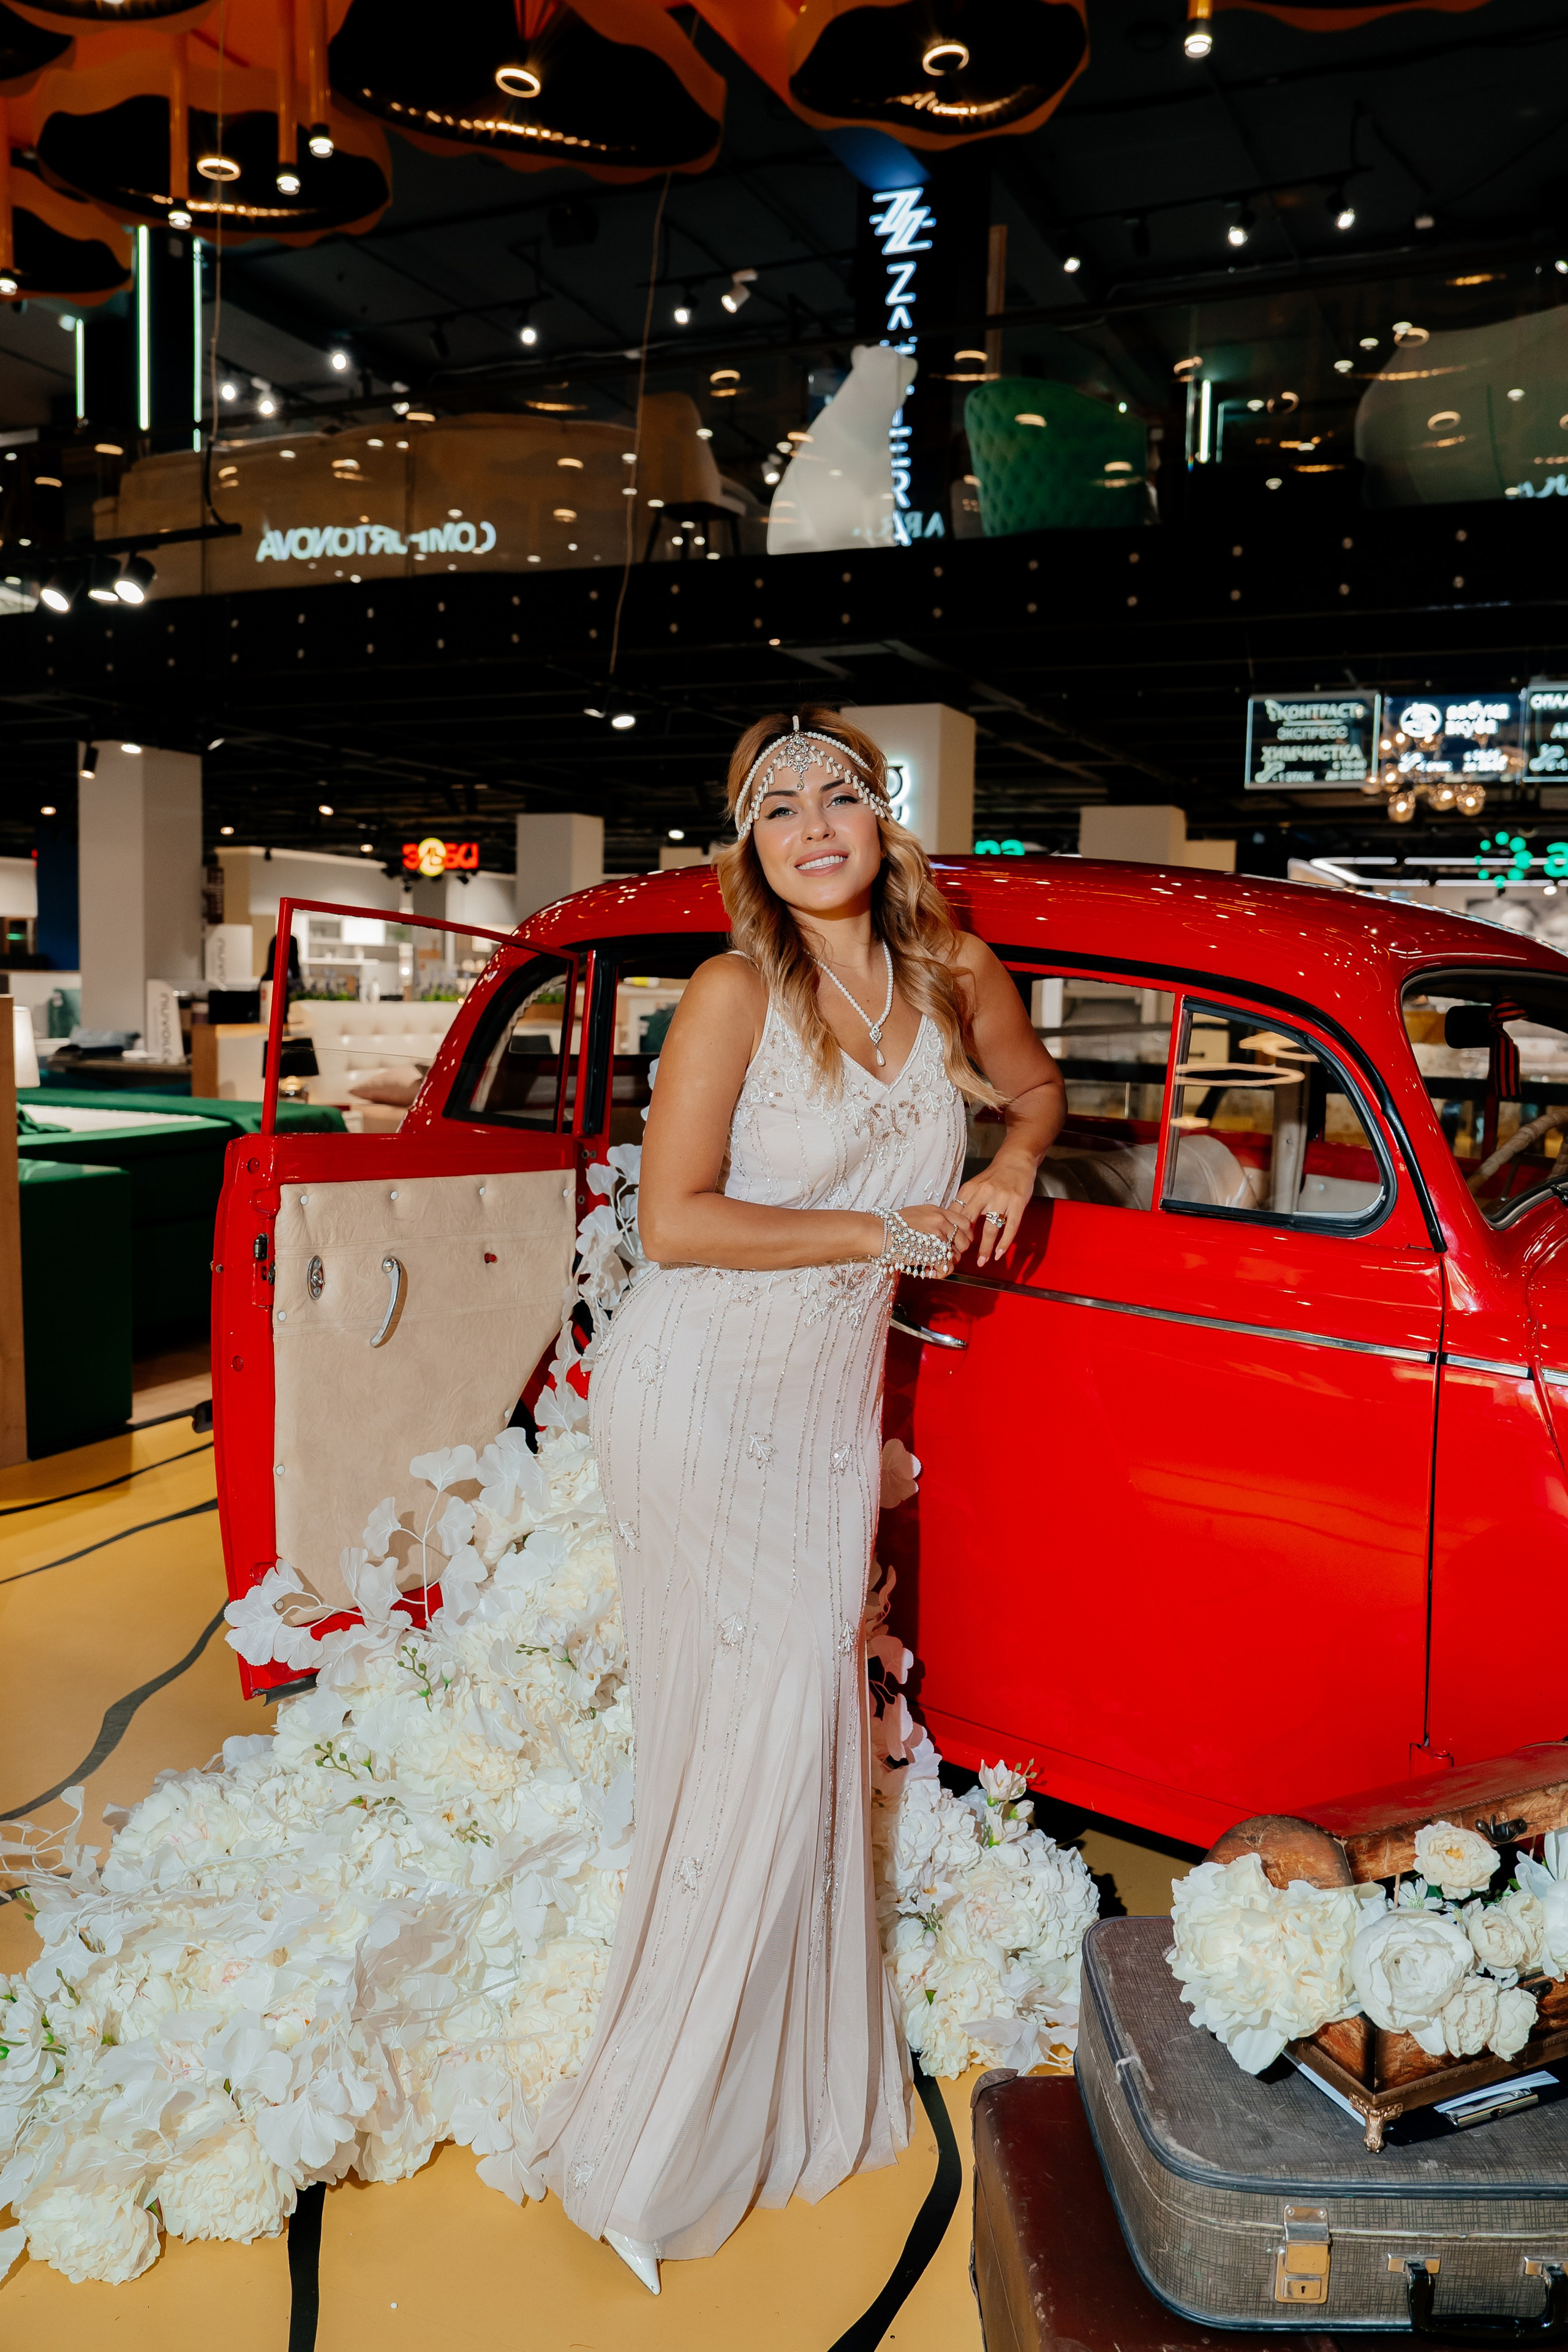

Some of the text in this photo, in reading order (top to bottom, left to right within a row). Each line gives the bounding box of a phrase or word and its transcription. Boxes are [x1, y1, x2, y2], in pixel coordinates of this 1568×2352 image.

[1277, 703, 1359, 721] КОНТРАСТ
[1277, 725, 1349, 741] ЭКСПРЕСС
[1261, 744, 1364, 762] ХИМЧИСТКА
